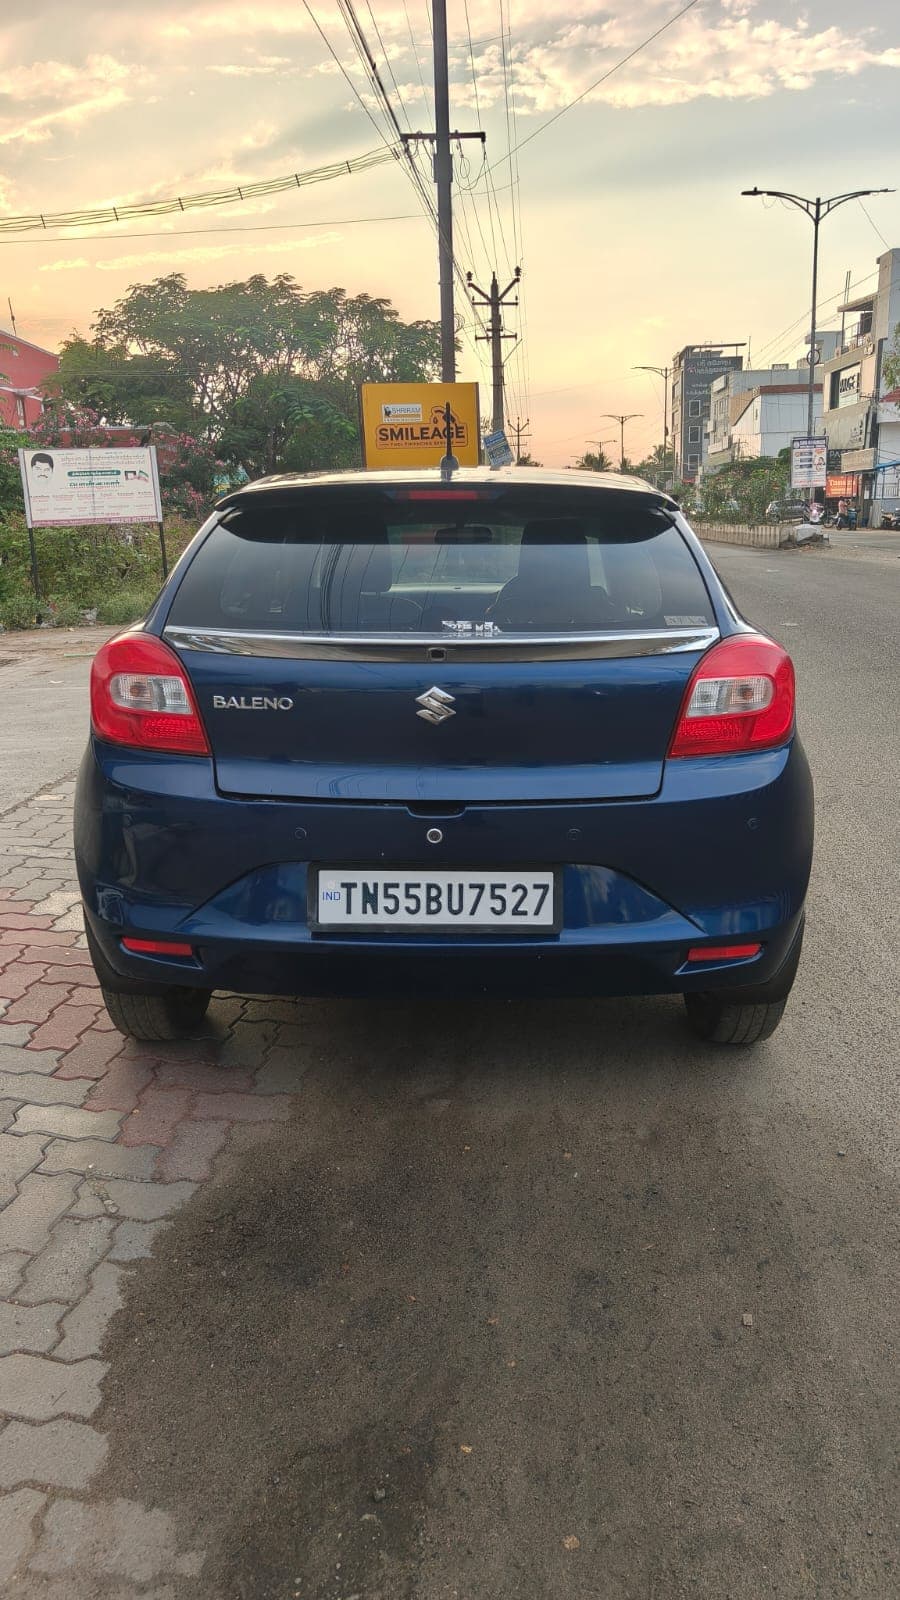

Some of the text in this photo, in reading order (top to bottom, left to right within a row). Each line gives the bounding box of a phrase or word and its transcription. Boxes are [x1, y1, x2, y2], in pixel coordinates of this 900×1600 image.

[378, 426, 465, 441] SMILEAGE
[213, 695, 294, 710] BALENO
[322, 891, 341, 901] IND
[340, 881, 550, 917] TN55BU7527
